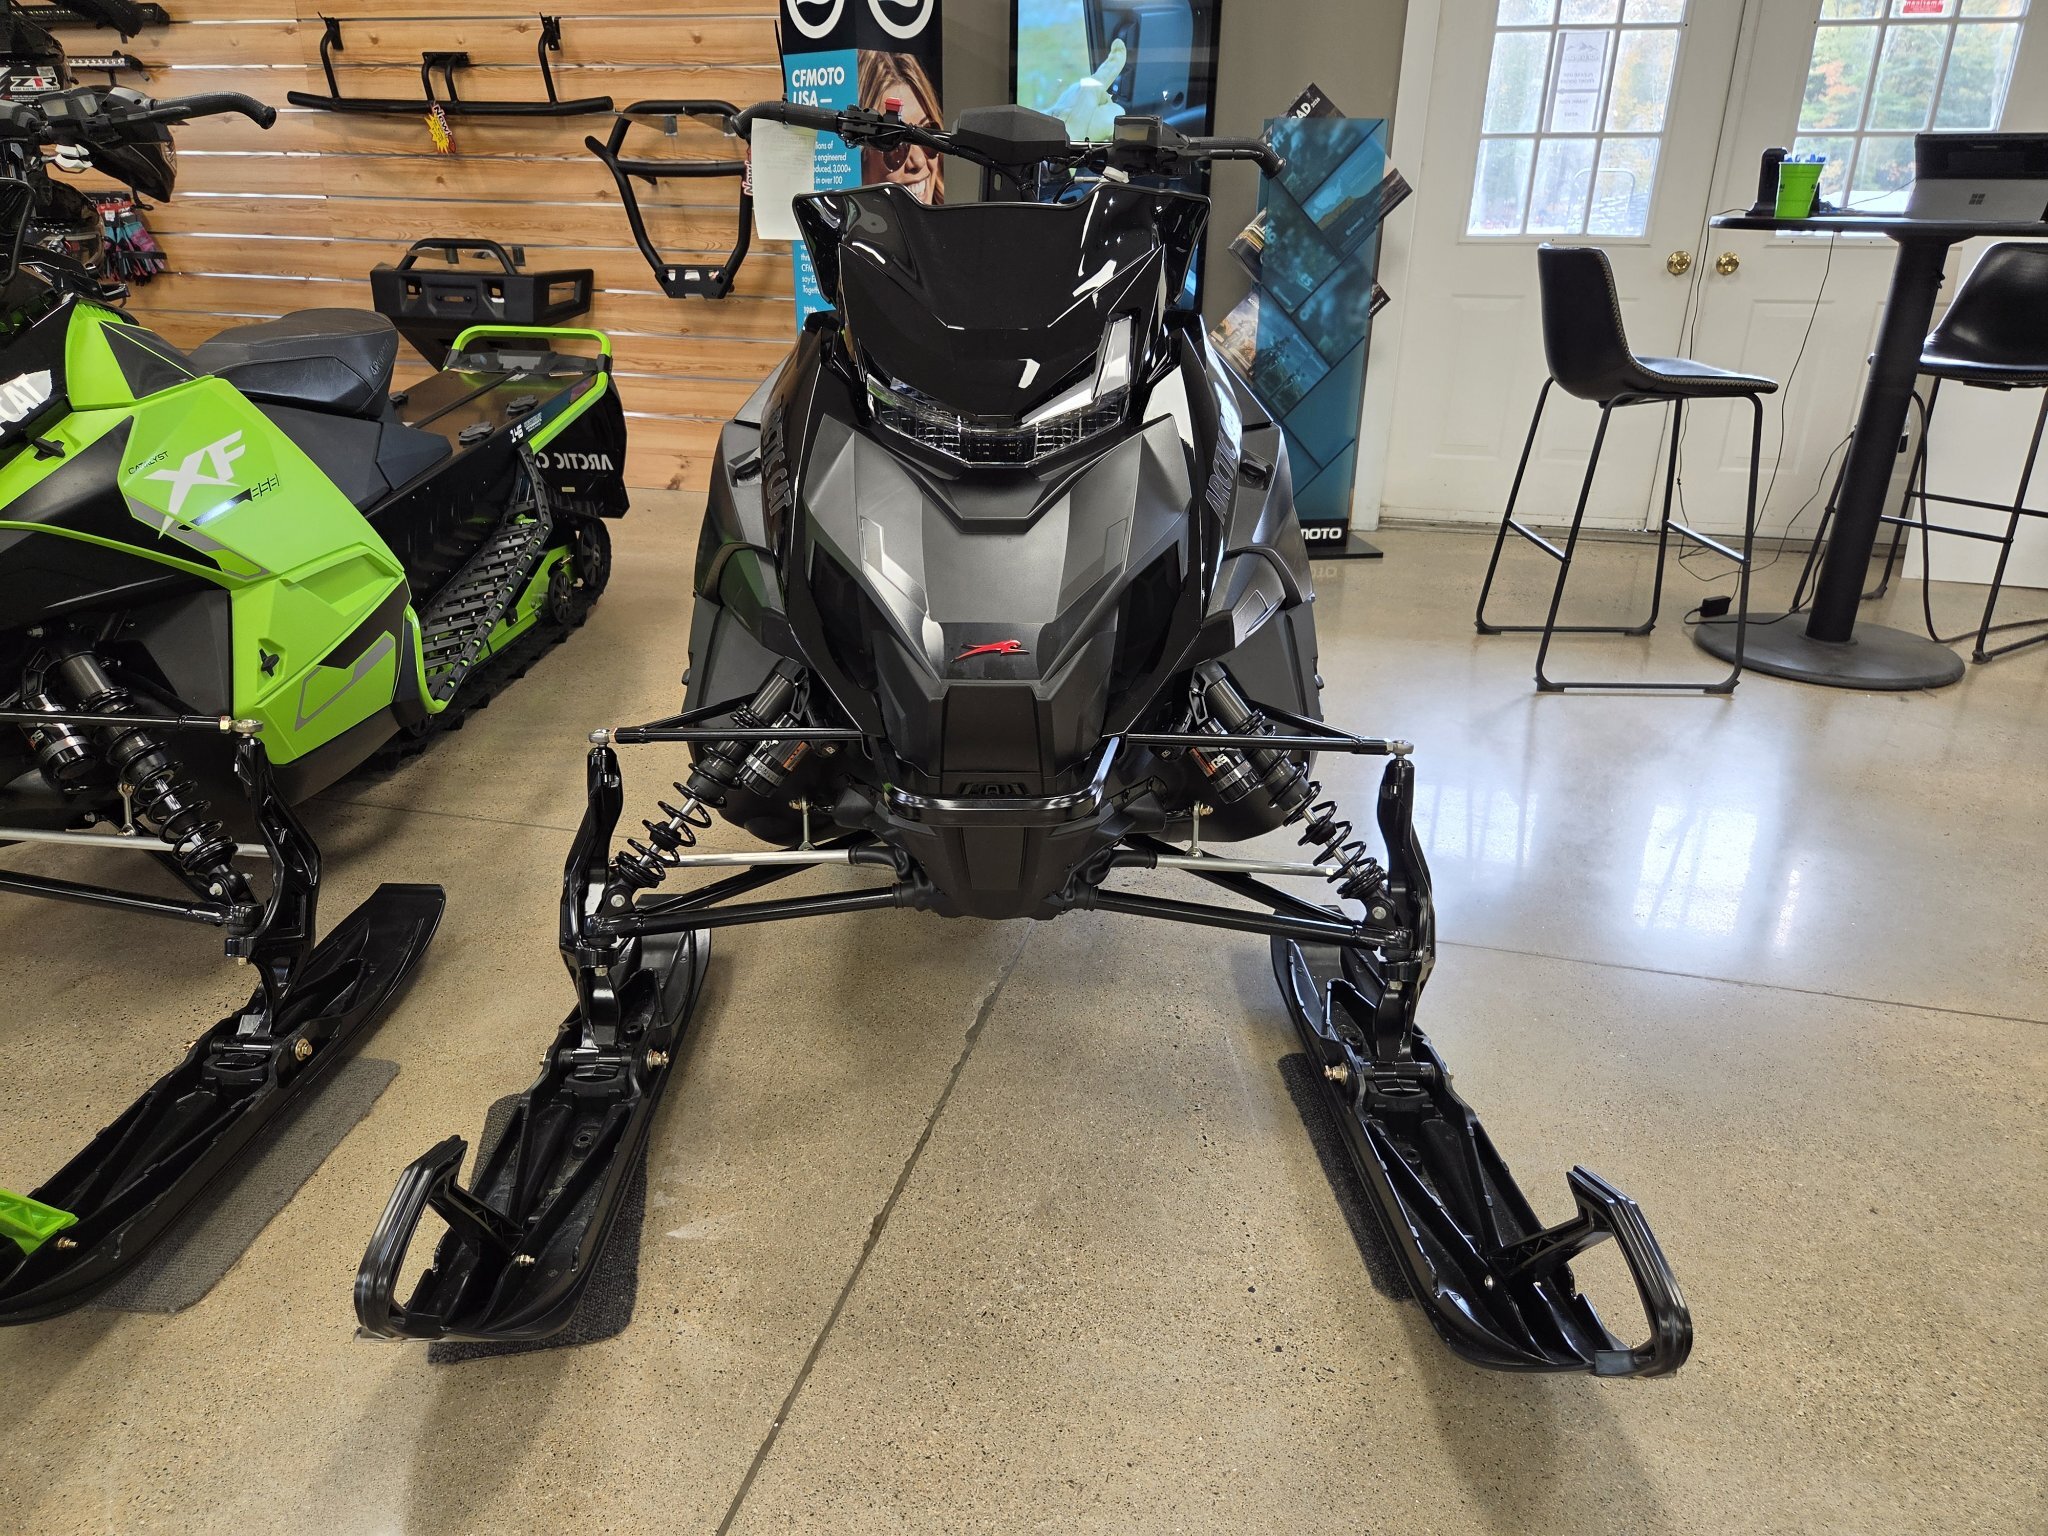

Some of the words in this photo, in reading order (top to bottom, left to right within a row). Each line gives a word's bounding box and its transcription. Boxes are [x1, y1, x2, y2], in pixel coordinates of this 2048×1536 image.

[792, 66, 845, 88] CFMOTO
[818, 152, 847, 164] engineered
[832, 164, 852, 173] 3,000+
[833, 176, 843, 184] 100
[128, 450, 169, 476] CATALYST
[143, 429, 246, 540] XF
[1205, 429, 1236, 527] ARCTIC
[767, 467, 793, 517] CAT
